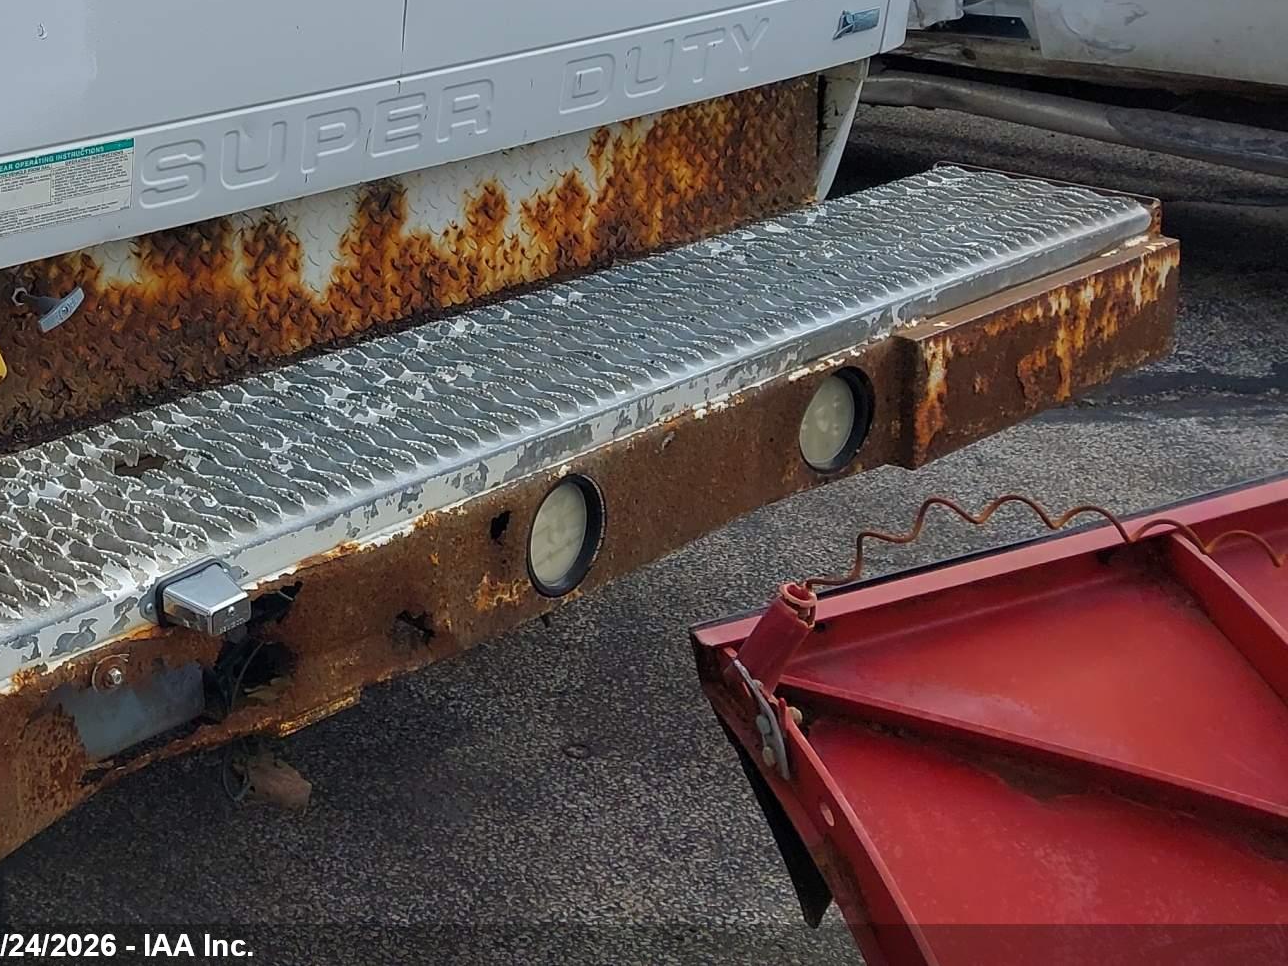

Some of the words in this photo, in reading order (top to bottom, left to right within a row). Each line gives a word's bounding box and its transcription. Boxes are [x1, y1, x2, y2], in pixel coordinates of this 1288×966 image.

[14, 155, 54, 169] OPERATING
[55, 146, 105, 161] INSTRUCTIONS
[139, 78, 495, 209] SUPER
[559, 17, 769, 115] DUTY
